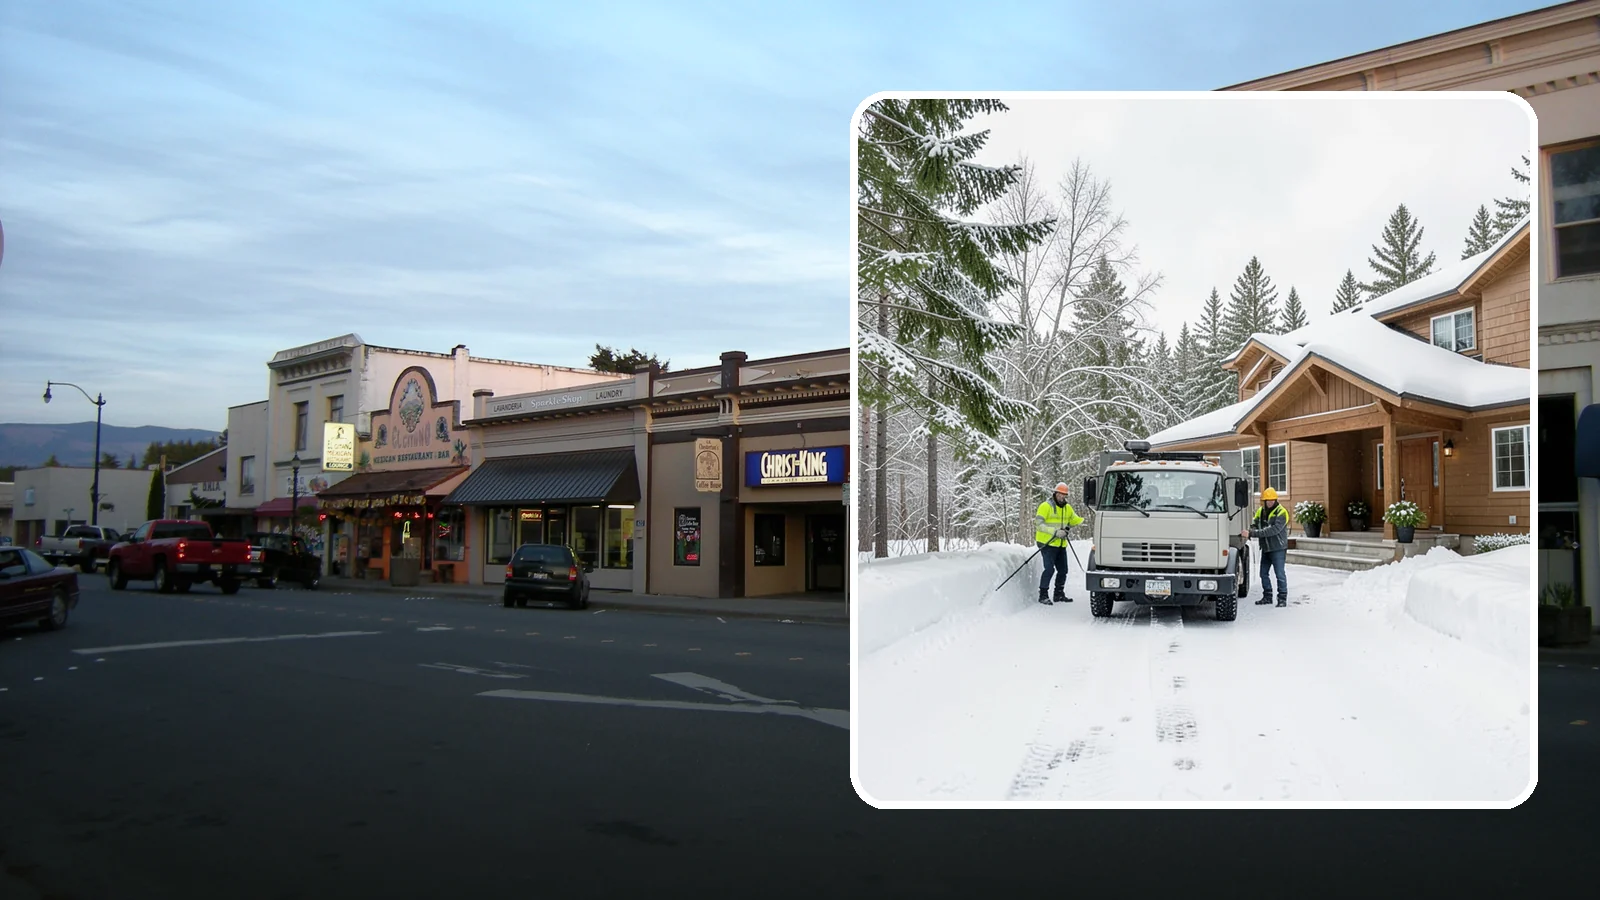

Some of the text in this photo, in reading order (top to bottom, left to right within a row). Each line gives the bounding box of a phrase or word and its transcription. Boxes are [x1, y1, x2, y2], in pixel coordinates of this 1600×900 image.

[595, 388, 624, 400] LAUNDRY
[493, 402, 523, 412] LAVANDERIA
[530, 394, 582, 409] Sparkle Shop
[374, 451, 450, 463] MEXICAN RESTAURANT BAR
[761, 450, 827, 478] CHRIST KING
[697, 480, 709, 489] Coffee
